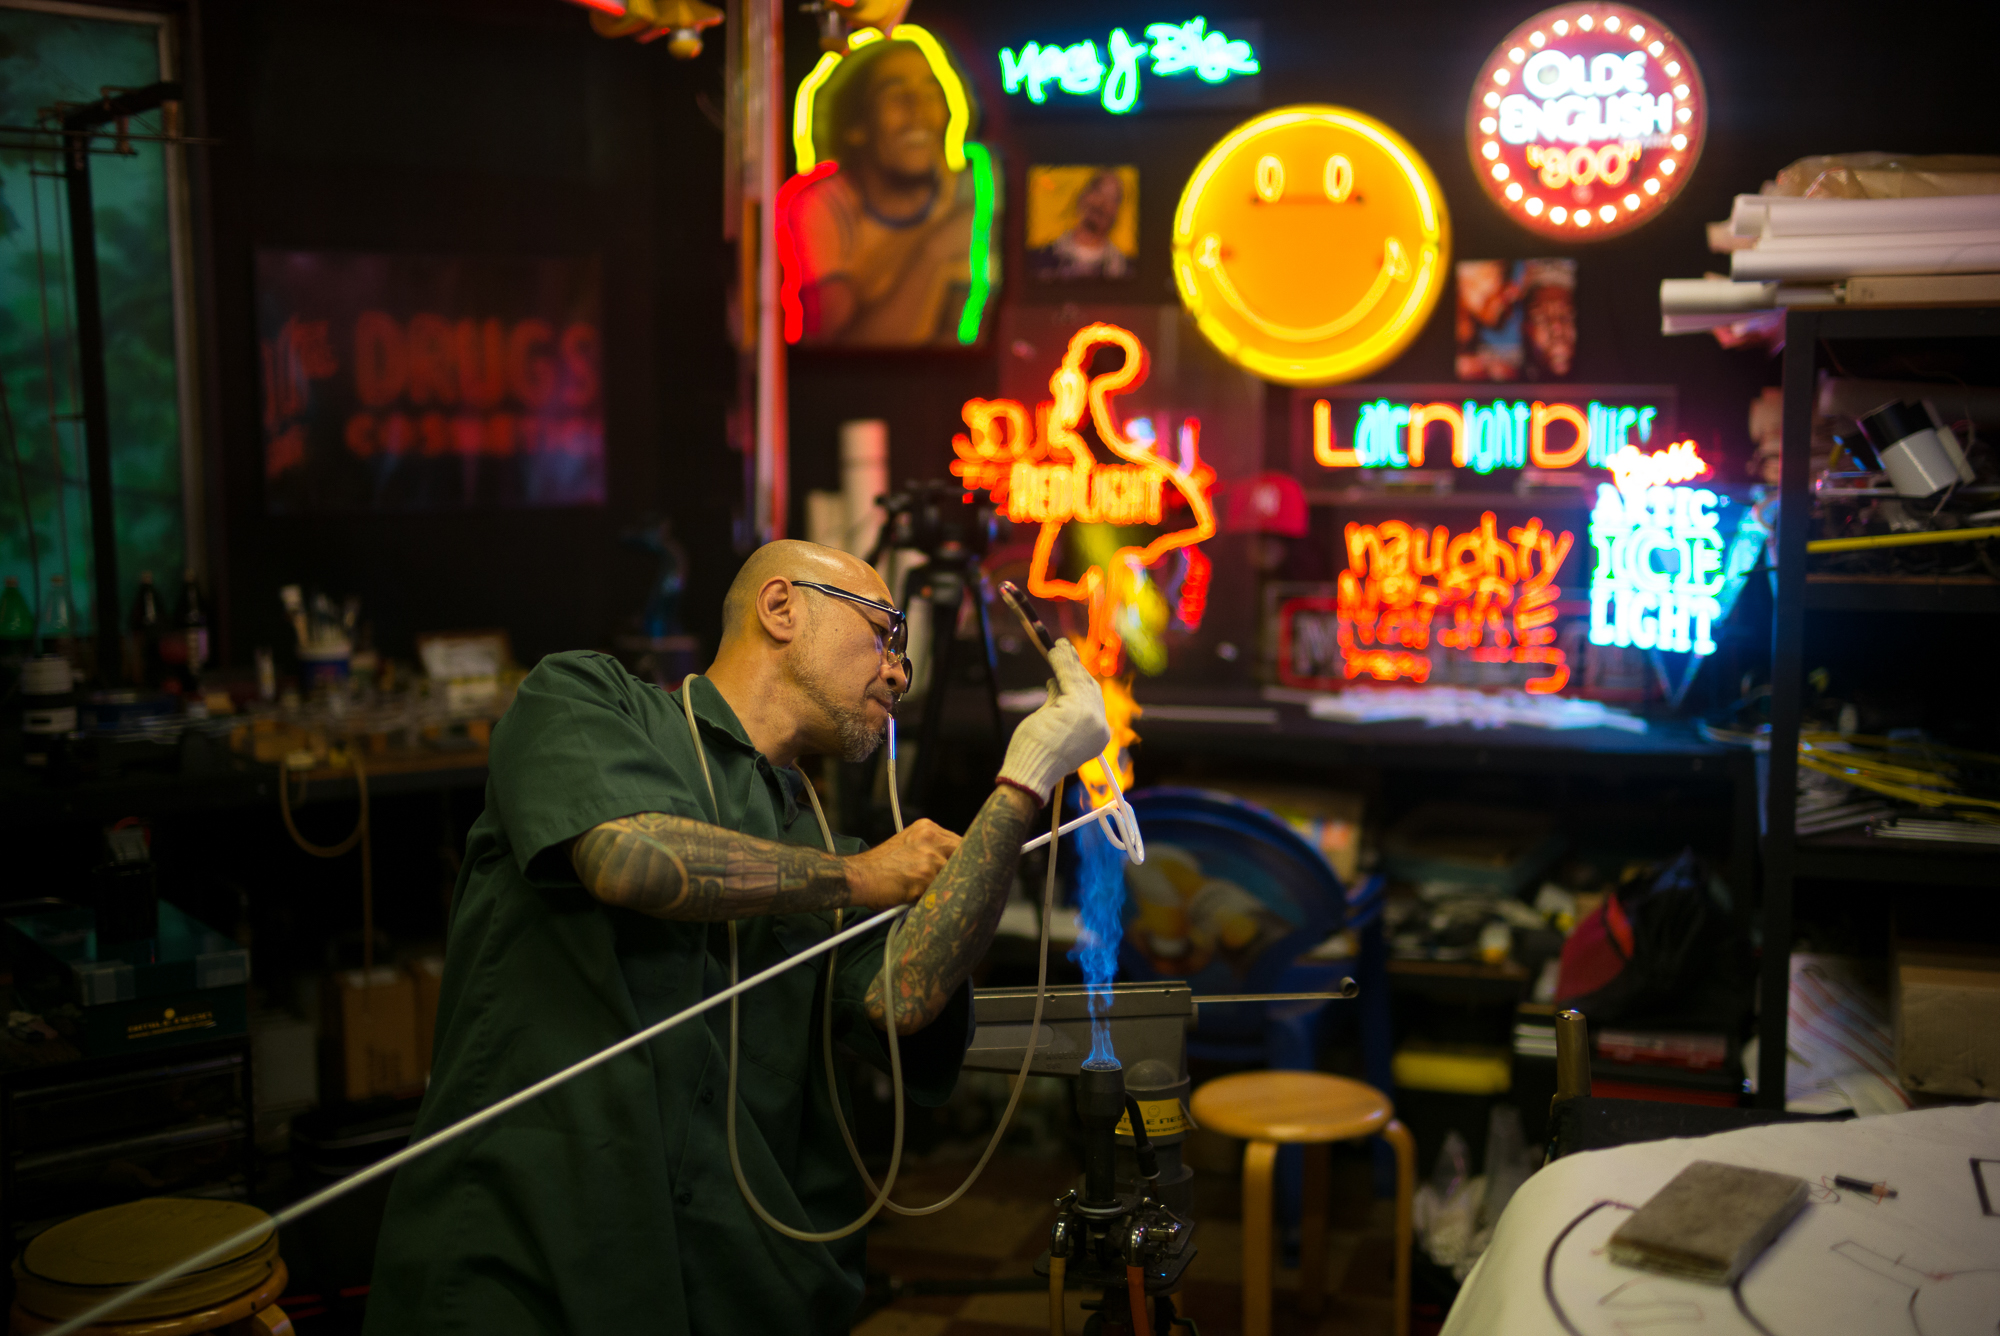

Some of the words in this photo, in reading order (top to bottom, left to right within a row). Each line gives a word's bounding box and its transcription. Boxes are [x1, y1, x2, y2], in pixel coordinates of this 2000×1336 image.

[1522, 49, 1648, 99] OLDE
[1499, 92, 1674, 146] ENGLISH
[354, 309, 600, 408] DRUGS
[1588, 588, 1722, 657] LIGHT
